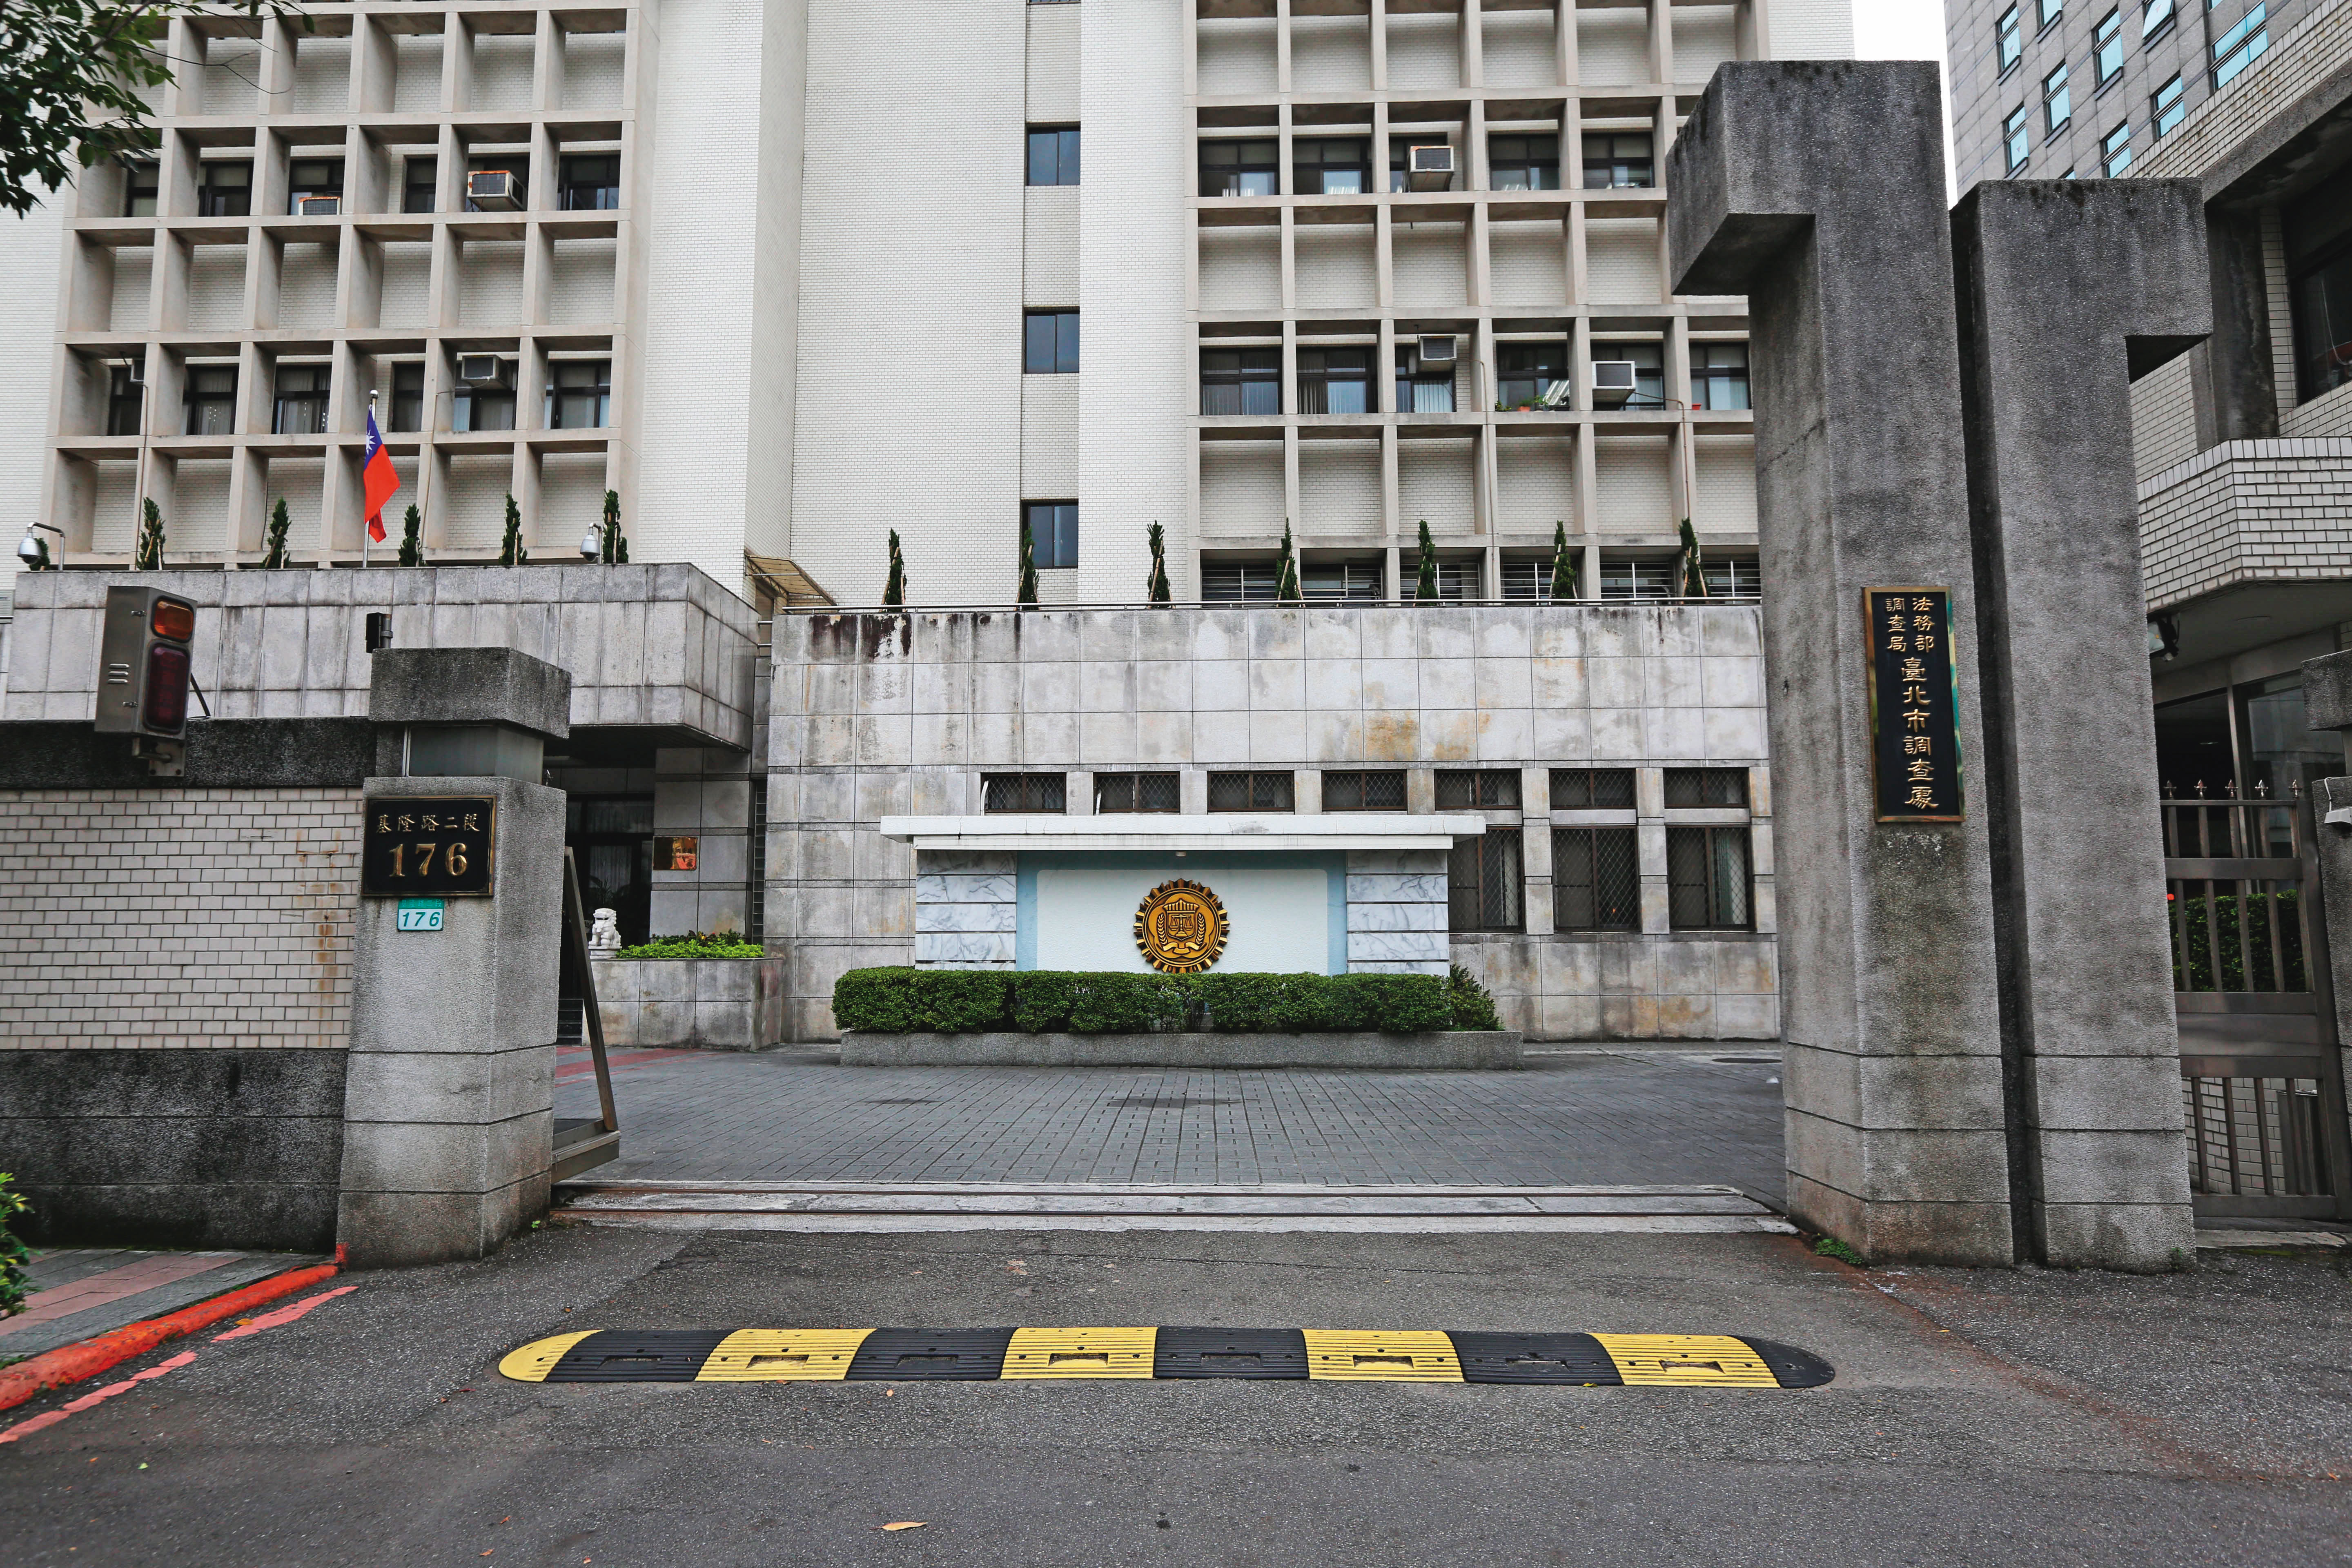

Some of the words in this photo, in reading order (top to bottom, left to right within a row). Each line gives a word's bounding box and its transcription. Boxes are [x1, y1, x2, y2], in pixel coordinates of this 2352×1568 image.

[1885, 598, 1907, 652] 調查局
[1912, 597, 1935, 653] 法務部
[1901, 657, 1939, 809] 臺北市調查處
[376, 814, 480, 833] 基隆路二段
[389, 842, 468, 878] 176
[403, 911, 440, 927] 176
